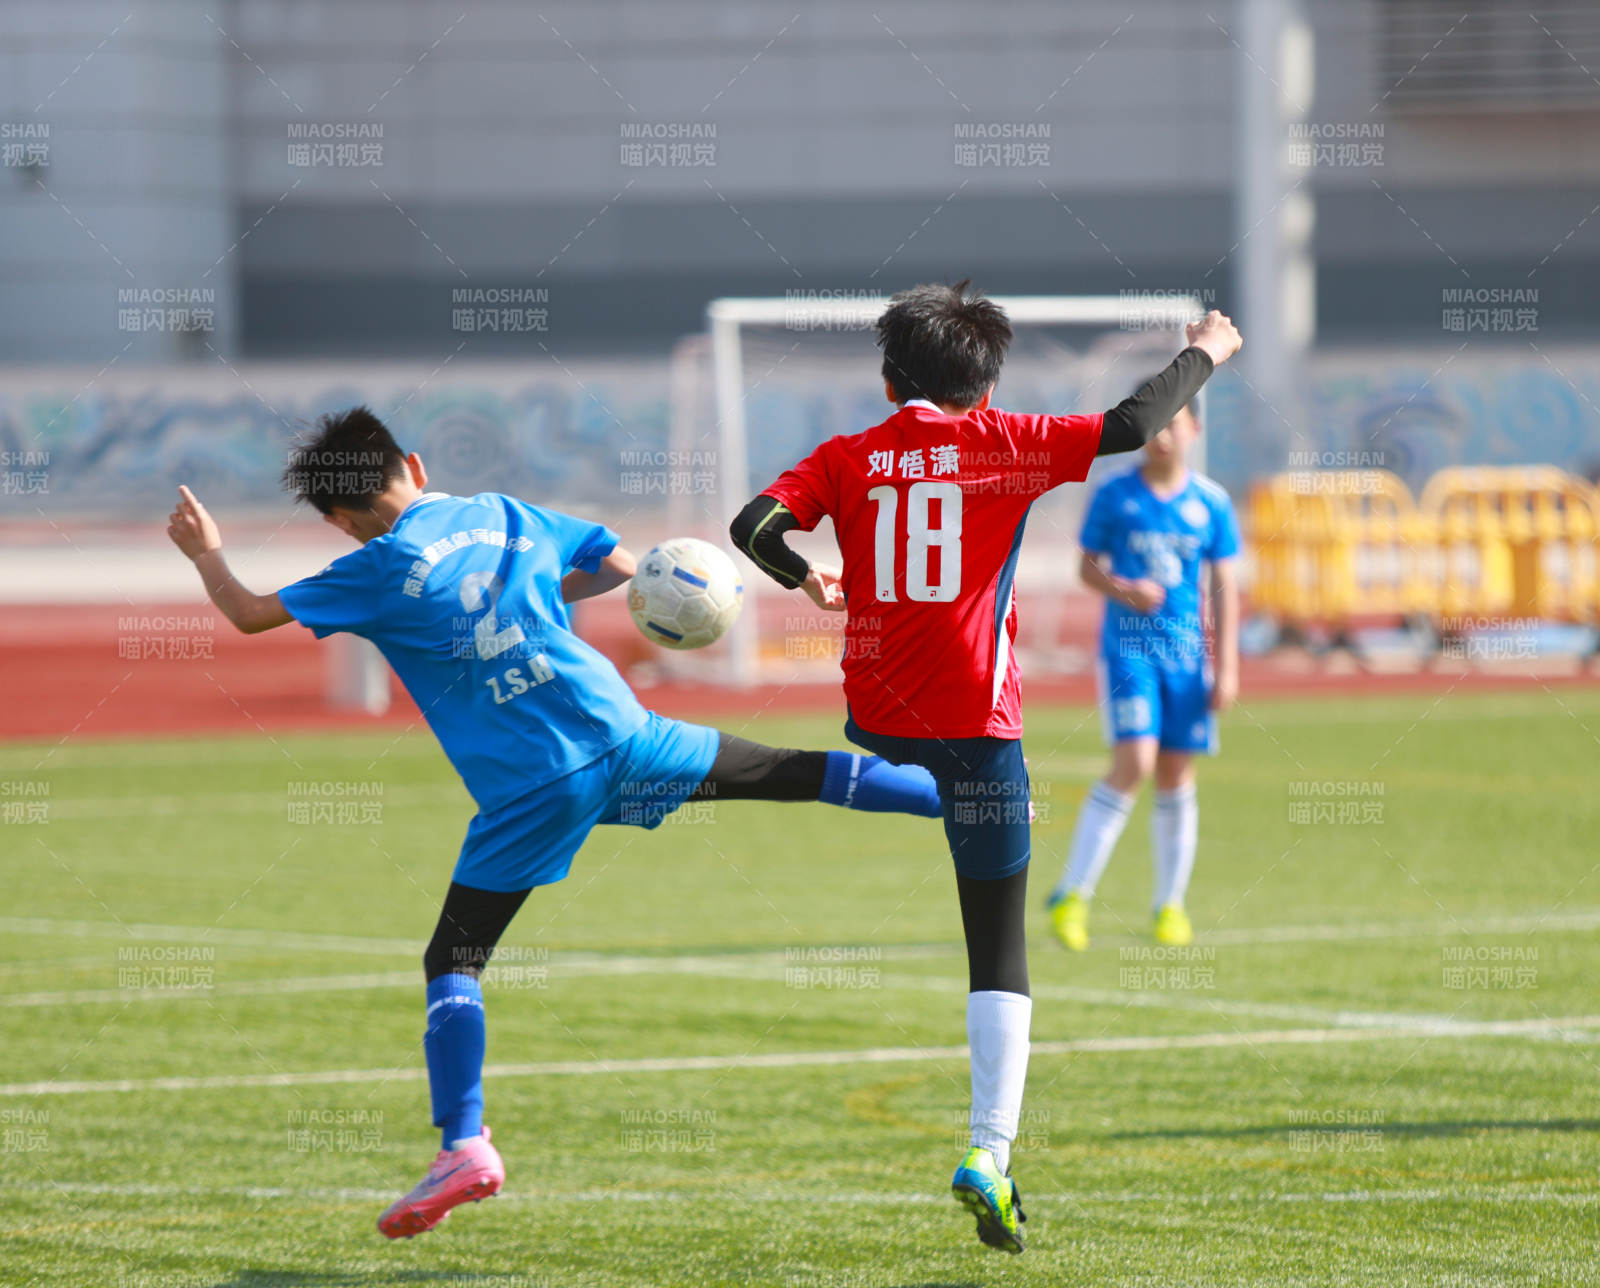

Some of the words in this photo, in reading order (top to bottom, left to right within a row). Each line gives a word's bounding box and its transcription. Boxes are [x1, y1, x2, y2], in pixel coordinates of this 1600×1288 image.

[866, 444, 960, 478] 刘悟潇
[868, 482, 963, 602] 18
[459, 570, 526, 661] 2
